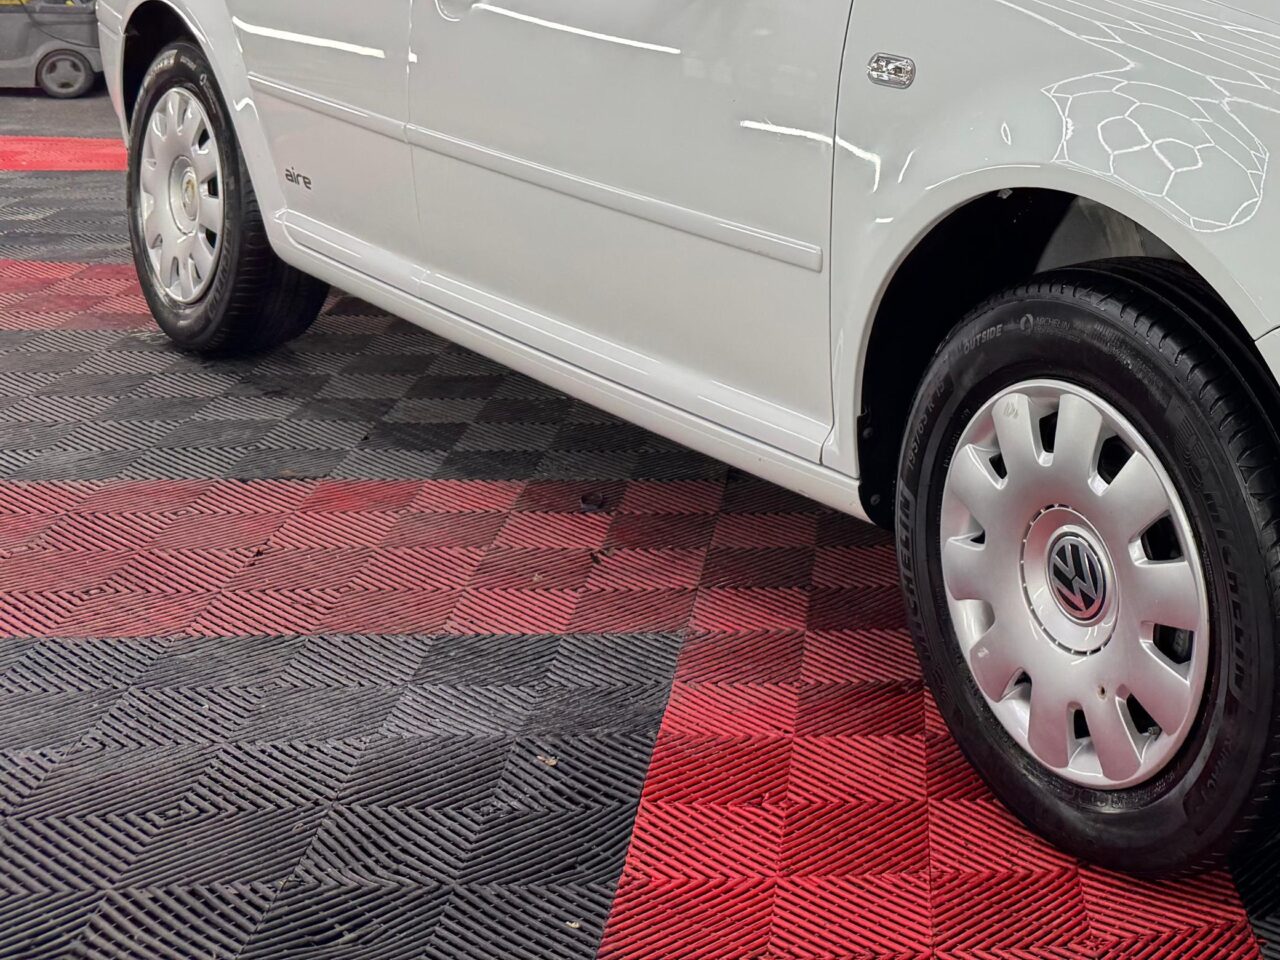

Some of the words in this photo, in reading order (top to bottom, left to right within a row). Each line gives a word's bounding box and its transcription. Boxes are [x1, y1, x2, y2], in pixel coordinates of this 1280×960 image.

[285, 166, 312, 190] aire
[962, 323, 1003, 354] OUTSIDE
[1052, 539, 1101, 615] VW
